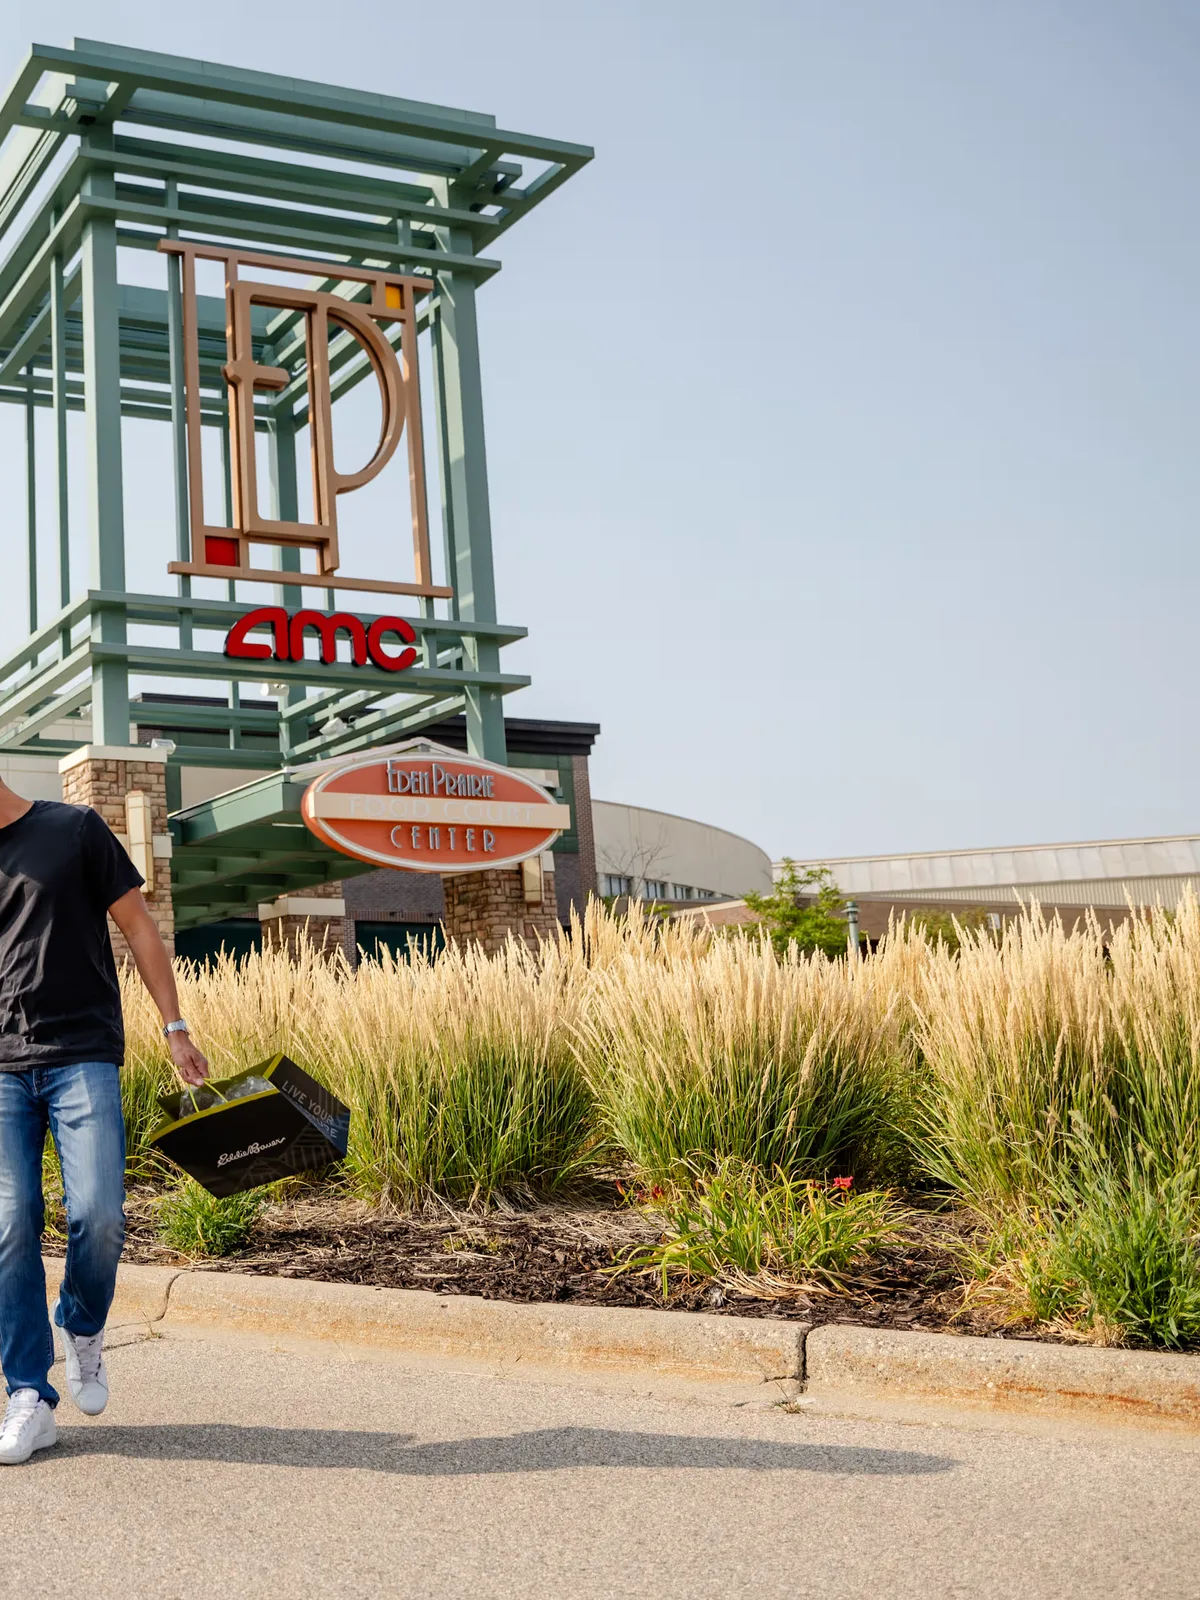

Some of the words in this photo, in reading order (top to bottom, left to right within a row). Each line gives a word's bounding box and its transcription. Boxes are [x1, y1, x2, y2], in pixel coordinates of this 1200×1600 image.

[386, 759, 430, 794] EDEN
[432, 763, 495, 798] PRAIRIE
[349, 795, 430, 819] FOOD
[443, 800, 536, 823] COURT
[390, 825, 496, 852] CENTER
[281, 1080, 307, 1104] LIVE
[308, 1099, 334, 1125] YOUR
